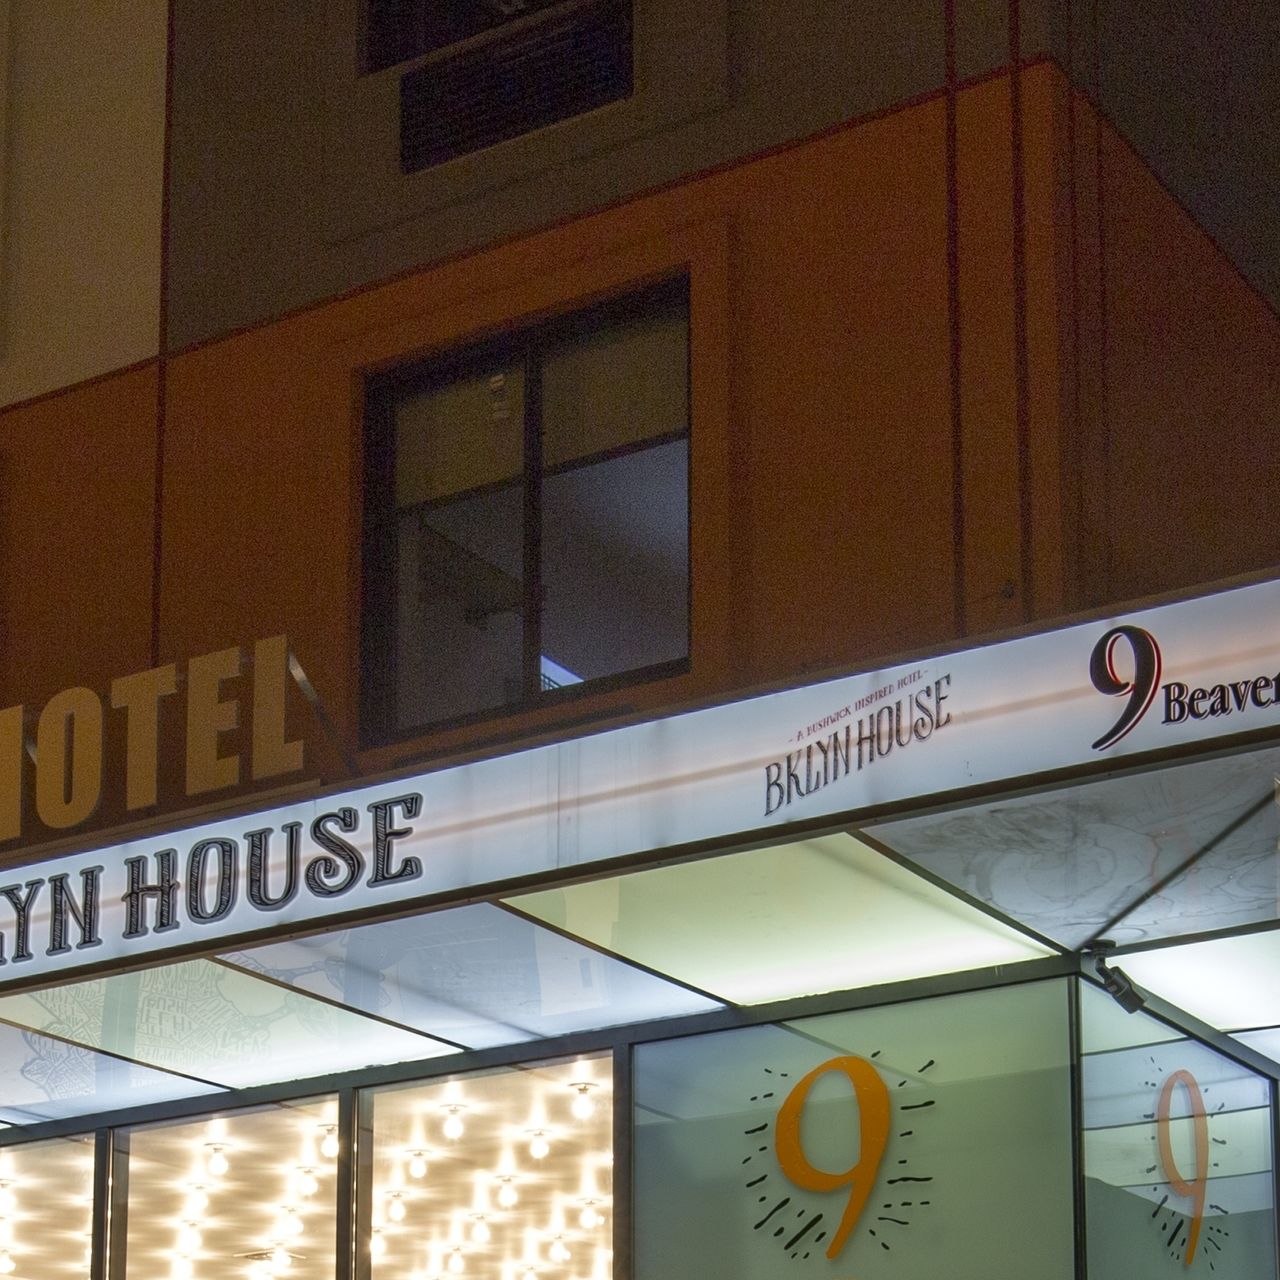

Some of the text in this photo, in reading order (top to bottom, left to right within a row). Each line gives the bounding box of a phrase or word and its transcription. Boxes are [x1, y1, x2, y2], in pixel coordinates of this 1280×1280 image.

[764, 673, 952, 816] BKLYN HOUSE
[807, 707, 851, 737] BUSHWICK
[854, 684, 894, 712] INSPIRED
[897, 669, 923, 689] HOTEL
[1090, 625, 1162, 751] 9
[121, 792, 424, 939] HOUSE
[775, 1056, 890, 1260] 9
[1158, 1070, 1209, 1265] 9
